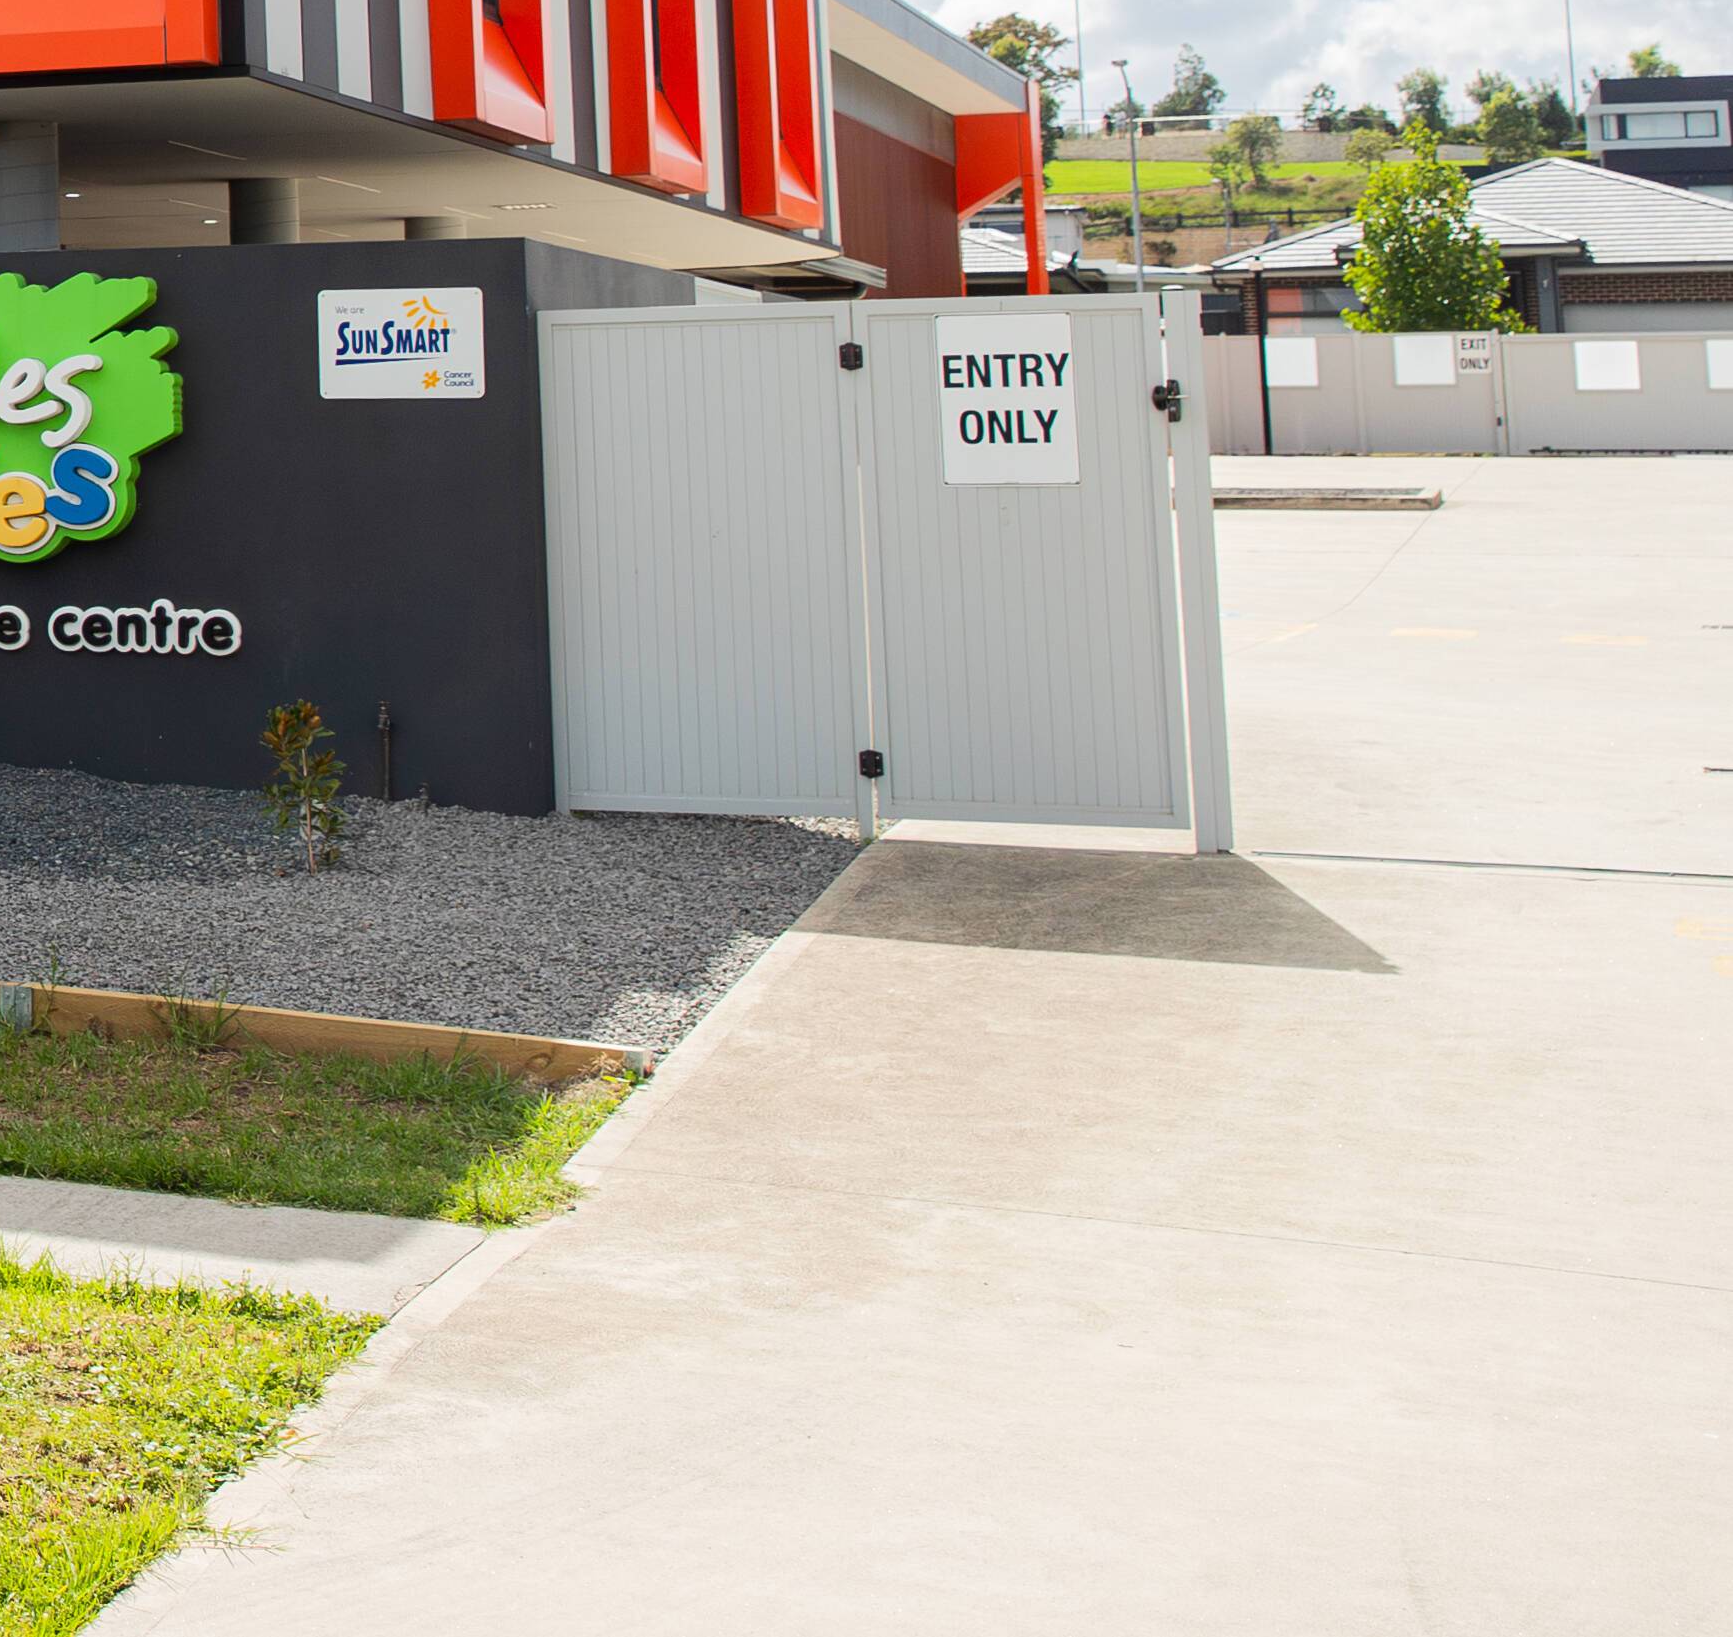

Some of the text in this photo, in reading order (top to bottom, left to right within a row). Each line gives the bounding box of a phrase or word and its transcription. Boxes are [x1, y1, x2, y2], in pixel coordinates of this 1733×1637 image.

[335, 306, 365, 315] We are
[1460, 338, 1486, 350] EXIT
[1460, 357, 1491, 370] ONLY
[444, 370, 472, 379] Cancer
[942, 352, 1070, 389] ENTRY
[443, 378, 475, 387] Council
[959, 409, 1059, 445] ONLY
[50, 601, 238, 653] centre
